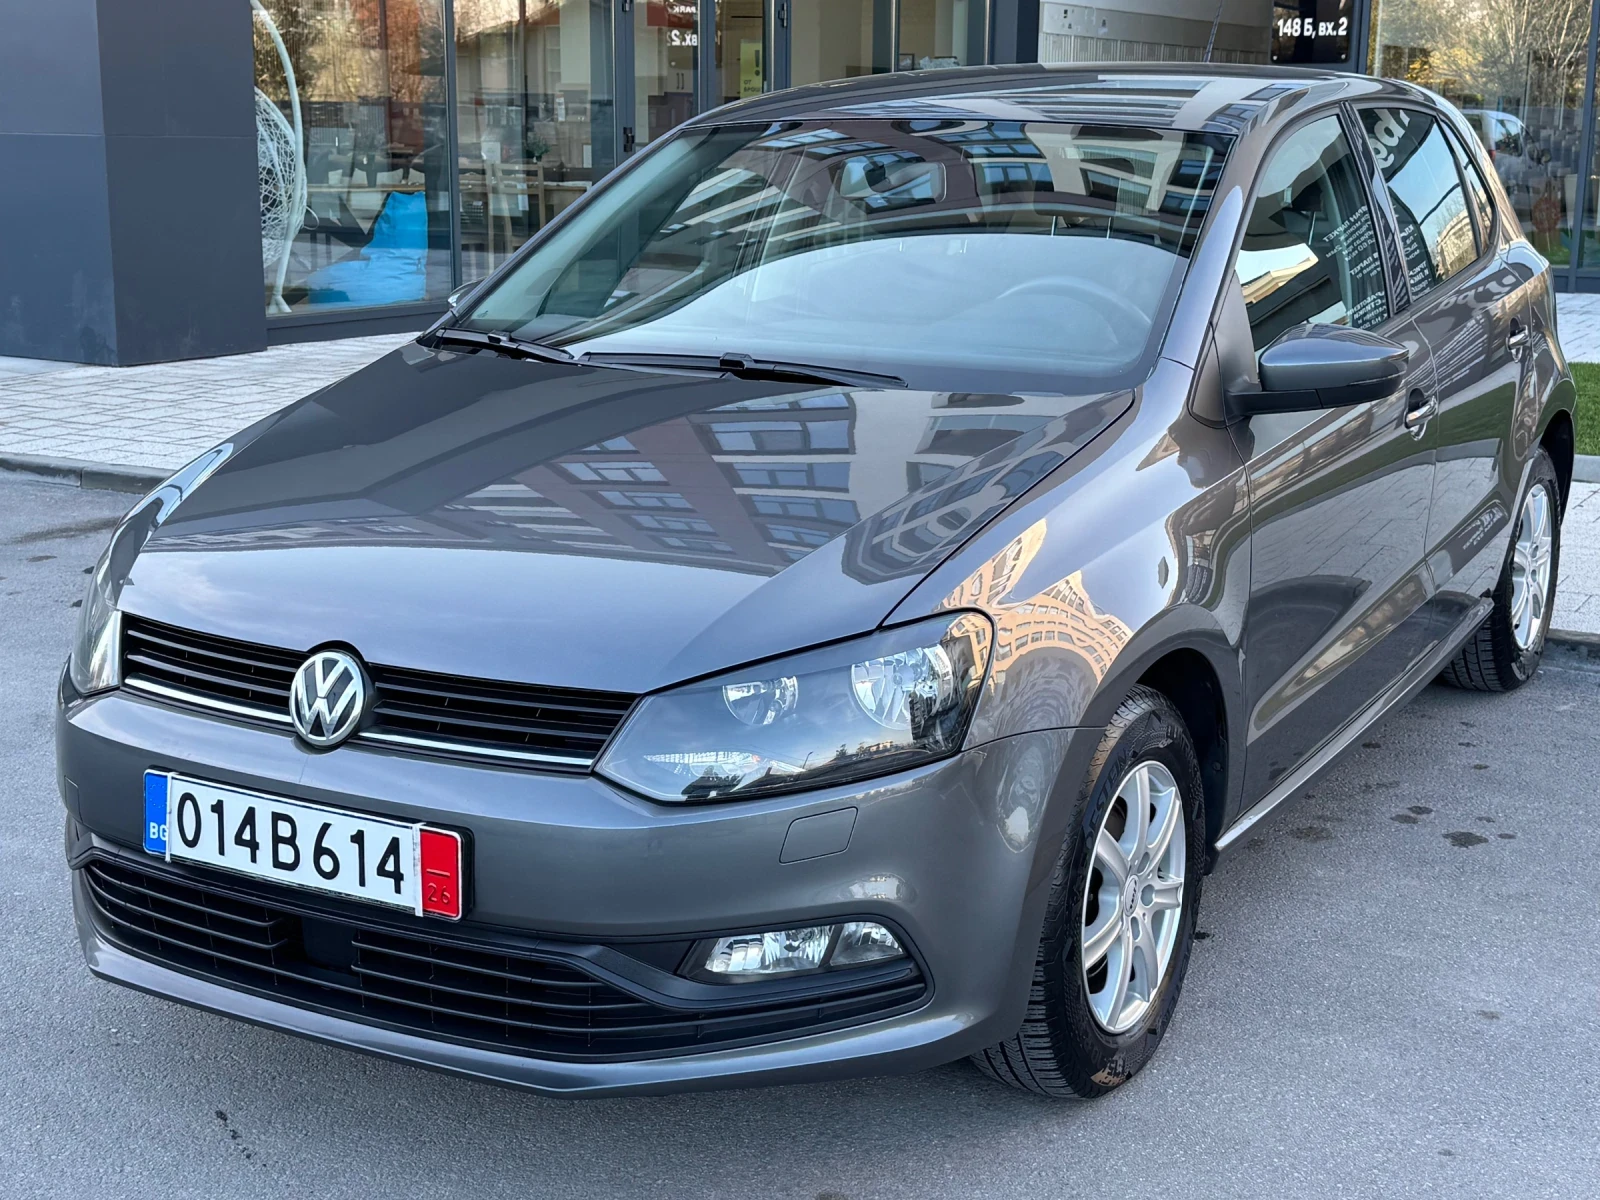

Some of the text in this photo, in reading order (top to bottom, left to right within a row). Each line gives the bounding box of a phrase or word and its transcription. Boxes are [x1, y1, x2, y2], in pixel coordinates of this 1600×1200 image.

[1277, 18, 1302, 37] 148
[150, 821, 168, 841] BG
[177, 792, 405, 895] 014B614
[427, 882, 451, 904] 26
